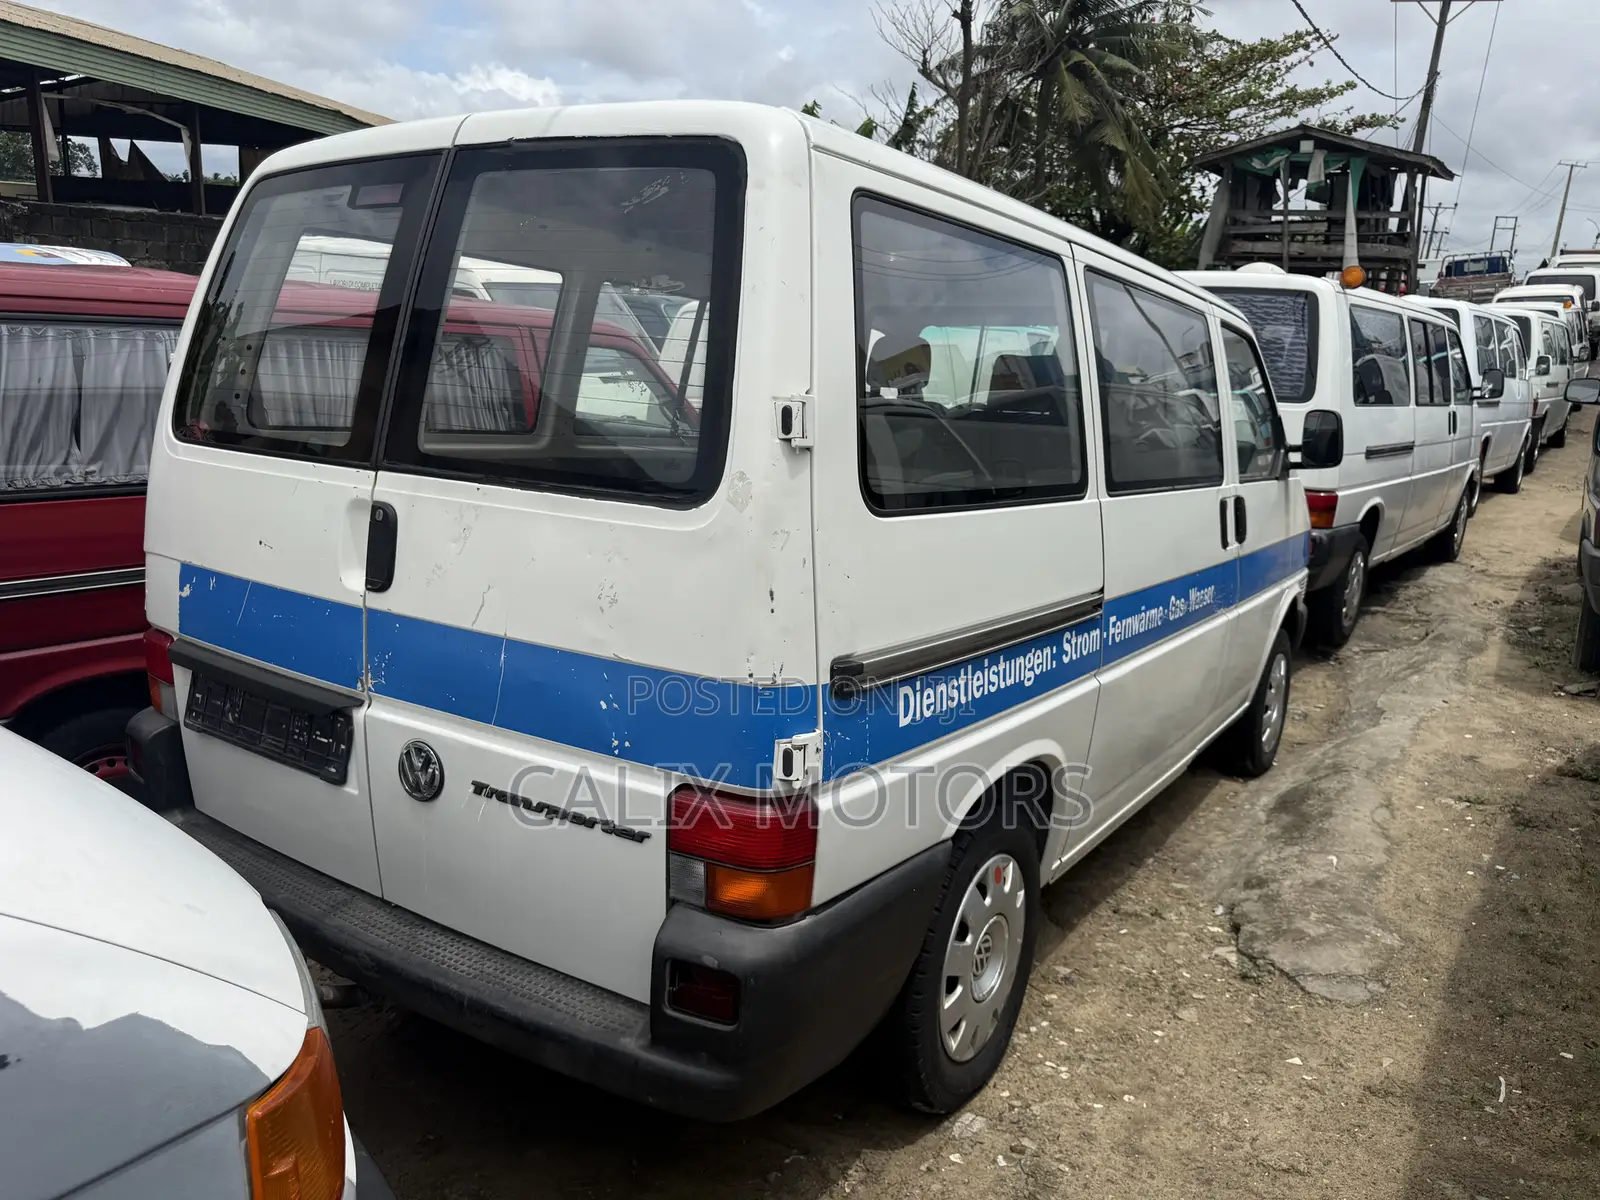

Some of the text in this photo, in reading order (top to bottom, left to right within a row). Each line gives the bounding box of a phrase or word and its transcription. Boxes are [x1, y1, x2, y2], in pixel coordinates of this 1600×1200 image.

[899, 646, 1056, 728] Dienstleistungen:
[1062, 626, 1100, 664] Strom
[1108, 605, 1164, 646] Fernwärme
[1168, 595, 1186, 621] Gas
[471, 779, 652, 844] Transporter
